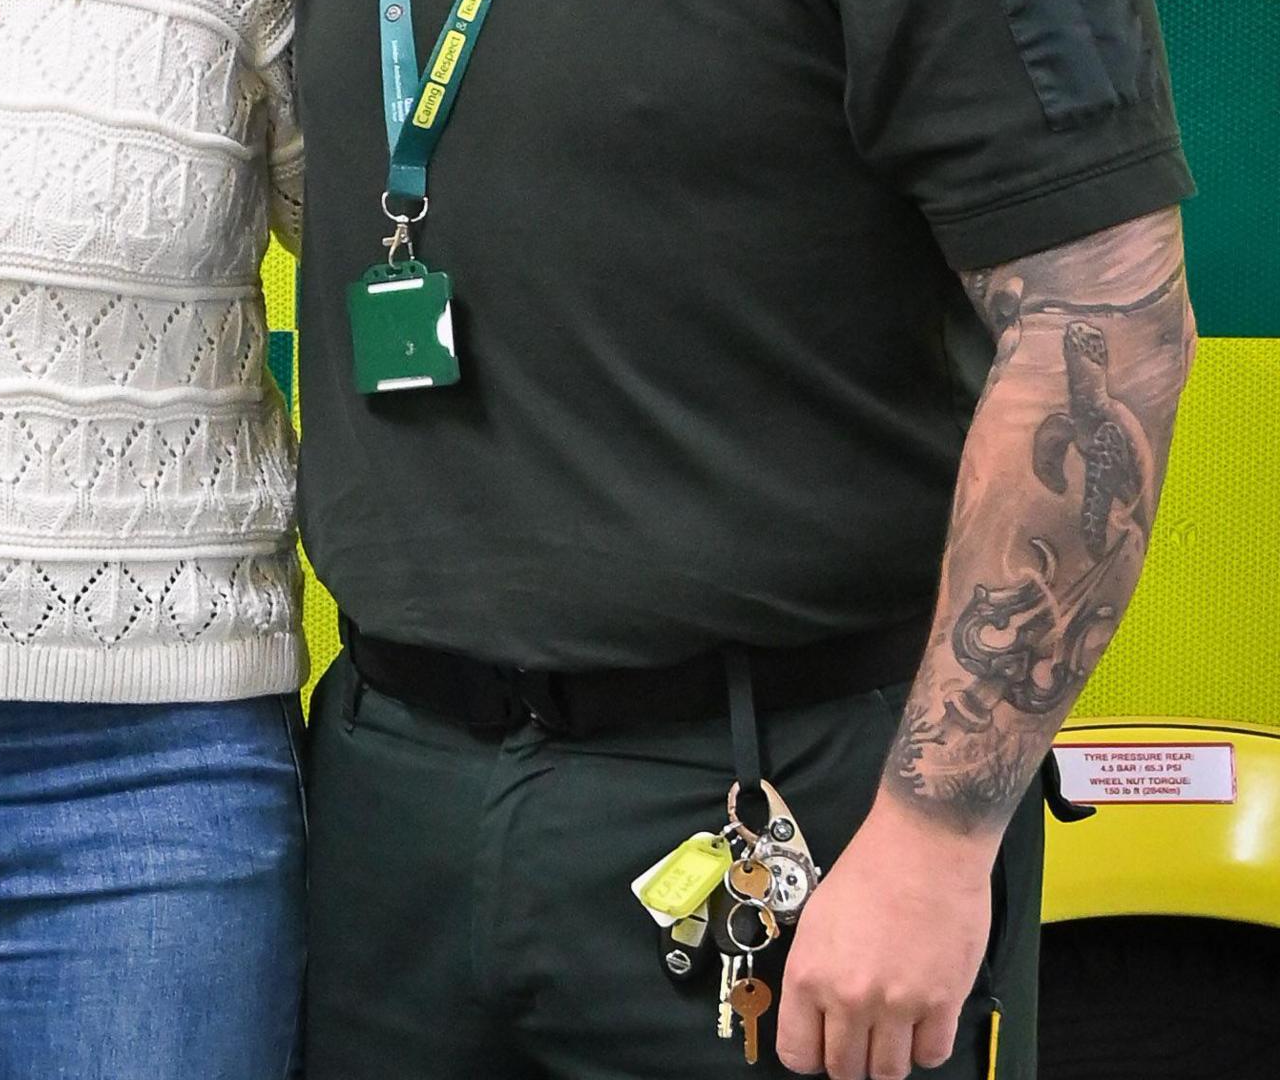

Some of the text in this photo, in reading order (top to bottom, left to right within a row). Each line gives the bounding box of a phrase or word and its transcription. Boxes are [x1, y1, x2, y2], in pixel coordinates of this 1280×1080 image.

[417, 86, 441, 126] Caring
[434, 35, 461, 80] Respect
[1084, 753, 1109, 761] TYRE
[1111, 753, 1162, 761] PRESSURE
[1116, 764, 1137, 772] BAR
[1166, 764, 1182, 772] PSI
[1089, 777, 1123, 785] WHEEL
[1125, 777, 1145, 785] NUT
